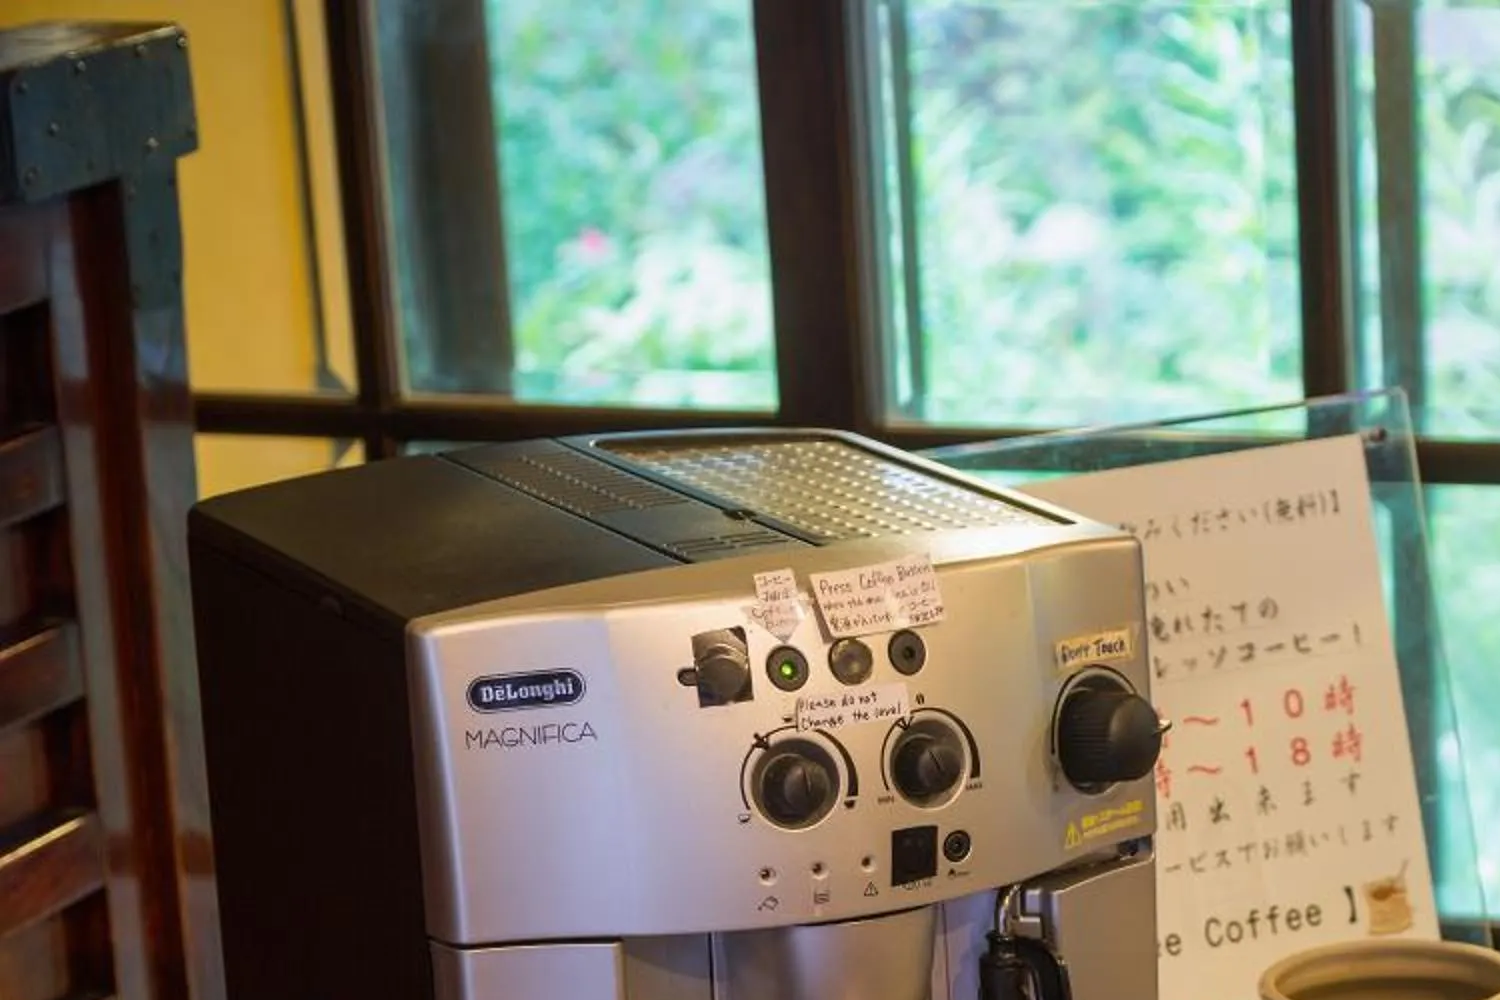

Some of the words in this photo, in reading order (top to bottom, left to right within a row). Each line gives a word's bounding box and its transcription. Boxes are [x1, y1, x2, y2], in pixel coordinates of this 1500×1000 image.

[465, 721, 598, 750] MAGNIFICA
[1157, 931, 1182, 957] e
[1204, 903, 1322, 948] Coffee
